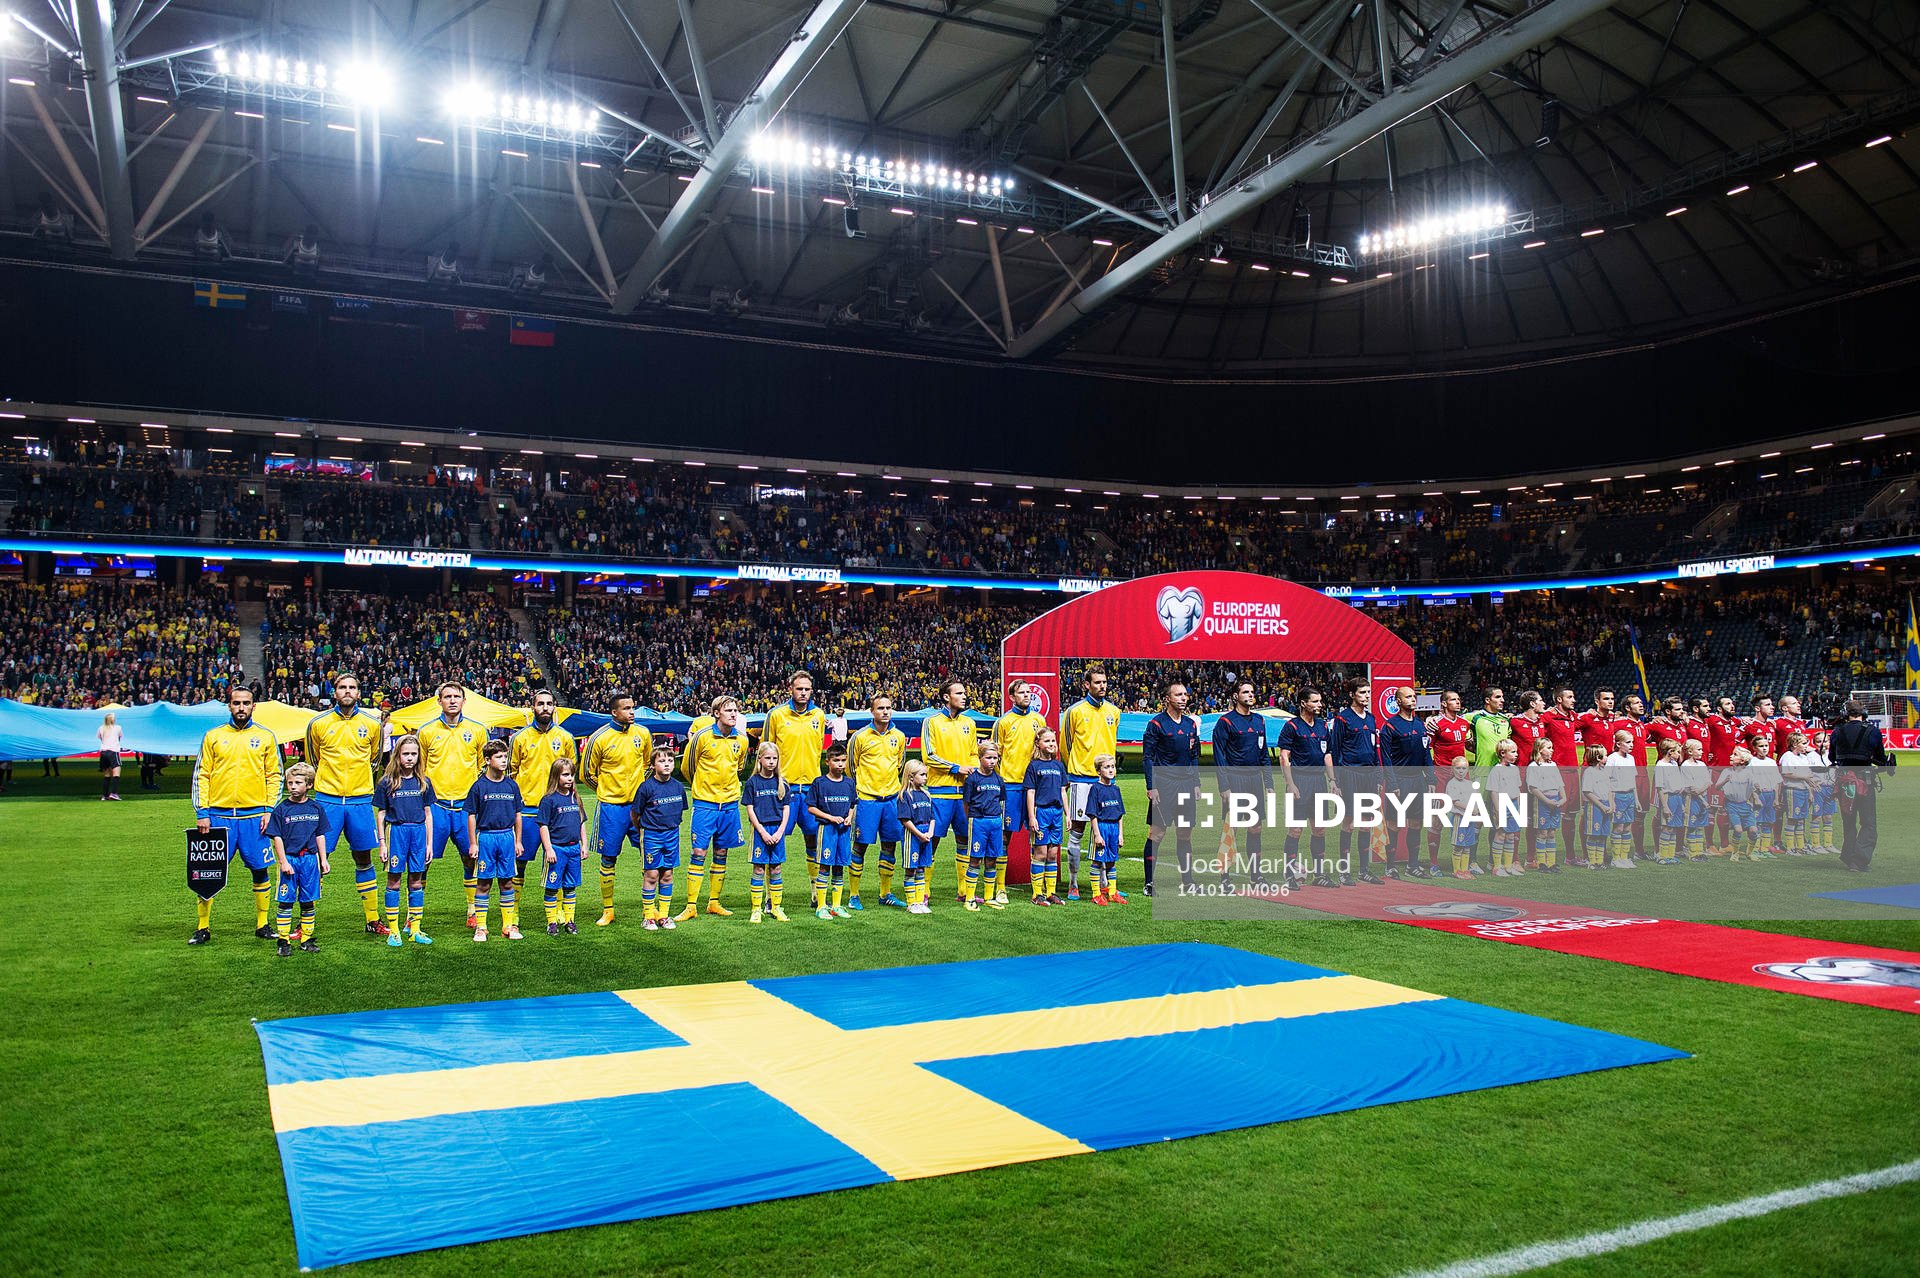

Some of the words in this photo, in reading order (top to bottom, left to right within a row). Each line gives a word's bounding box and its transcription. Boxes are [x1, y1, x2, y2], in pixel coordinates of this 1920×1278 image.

[279, 295, 302, 305] FIFA
[344, 549, 472, 567] NATIONALSPORTEN
[1678, 555, 1775, 577] NATIONALSPORTEN
[738, 565, 841, 581] NATIONALSPORTEN
[1325, 586, 1352, 596] 00:00
[1213, 601, 1281, 617] EUROPEAN
[1204, 617, 1290, 636] QUALIFIERS
[1453, 730, 1462, 741] 10
[1531, 726, 1540, 737] 18
[1635, 726, 1642, 737] 11
[1675, 729, 1682, 740] 6
[191, 840, 208, 851] NO
[209, 840, 225, 851] TO
[190, 851, 225, 861] RACISM
